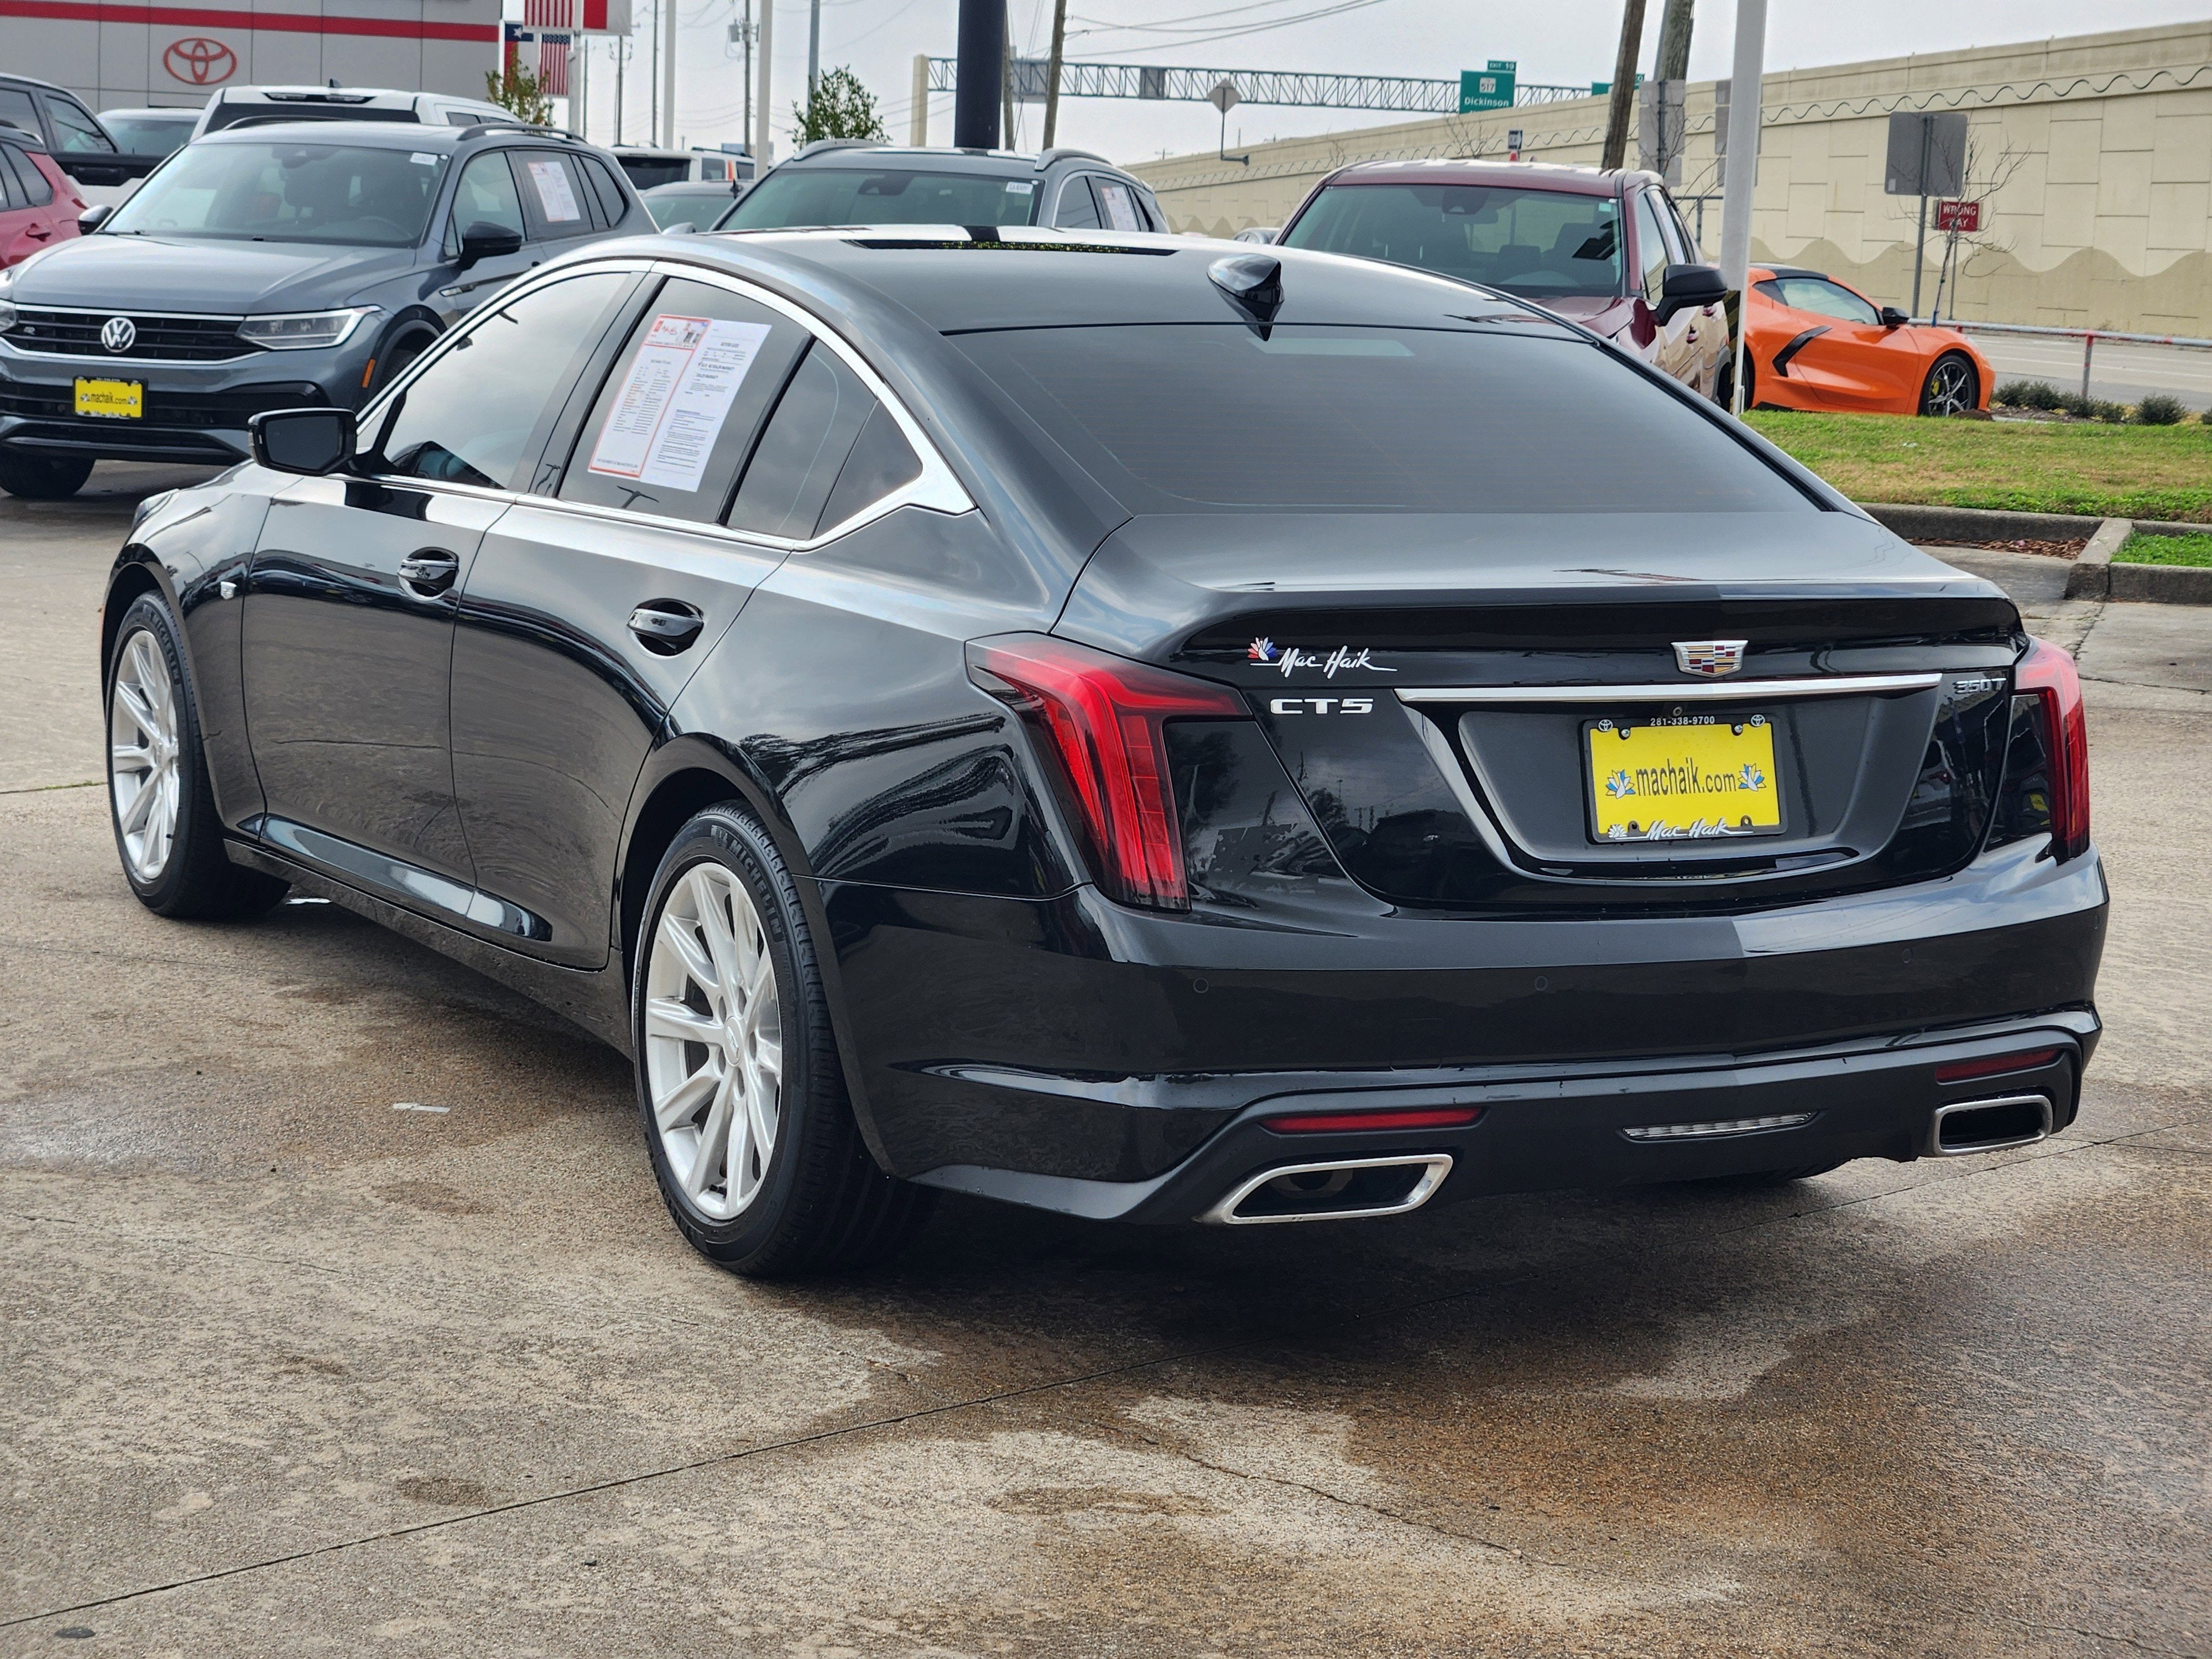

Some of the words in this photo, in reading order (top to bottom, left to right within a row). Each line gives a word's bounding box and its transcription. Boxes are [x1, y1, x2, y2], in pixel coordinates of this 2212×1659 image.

[1481, 83, 1495, 91] 517
[1464, 96, 1509, 108] Dickinson
[90, 391, 127, 405] machaik.com
[1250, 647, 1324, 678] Mac
[1323, 645, 1399, 679] Haik
[1954, 677, 2007, 693] 350T
[1270, 698, 1374, 714] CT5
[1650, 716, 1715, 726] 281-338-9700
[1635, 757, 1738, 797] machaik.com
[1615, 820, 1688, 841] Mac
[1687, 817, 1754, 839] Haik
[729, 839, 783, 935] MICHELIN
